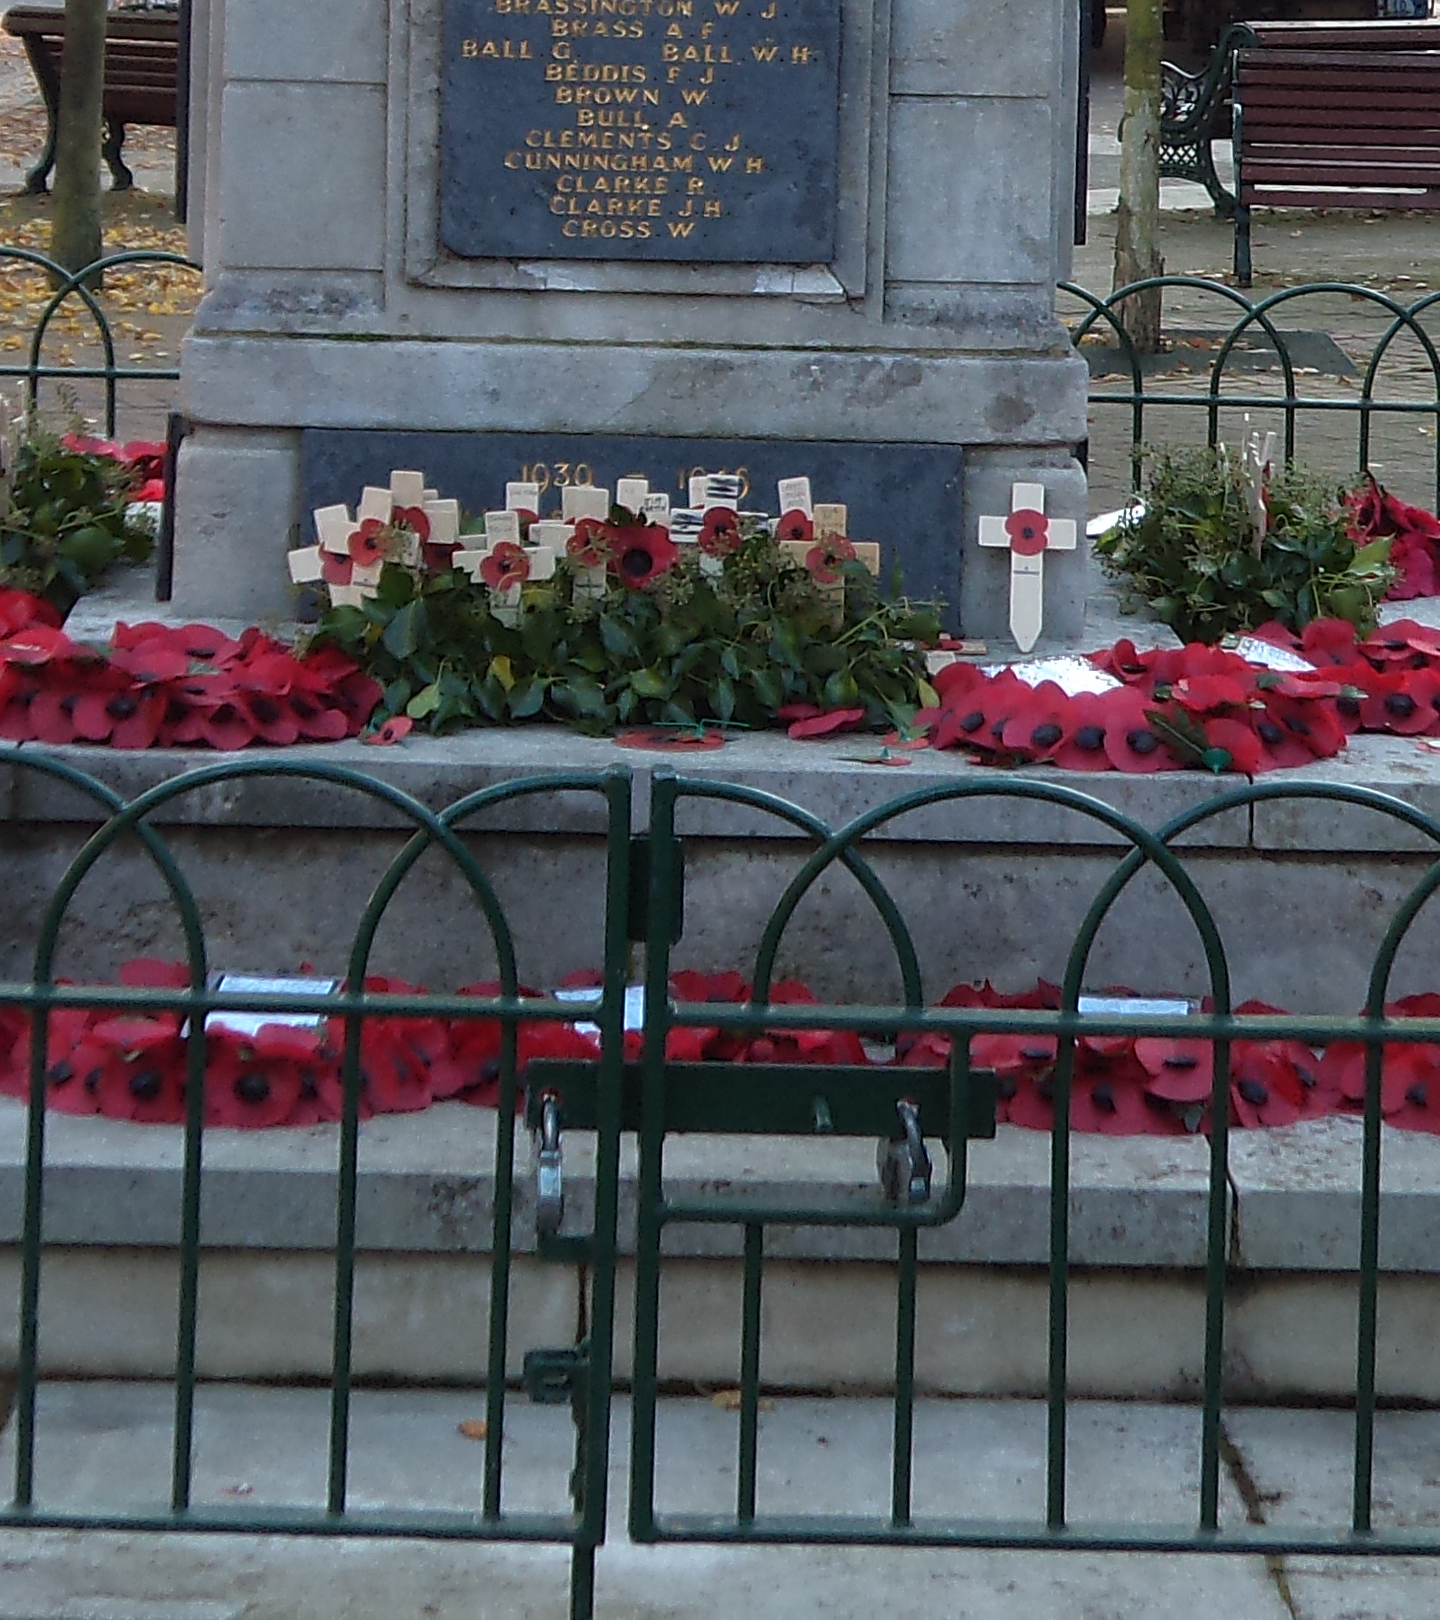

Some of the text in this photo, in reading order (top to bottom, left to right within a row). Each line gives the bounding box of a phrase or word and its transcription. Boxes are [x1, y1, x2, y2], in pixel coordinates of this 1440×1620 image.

[551, 18, 645, 39] BRASS
[462, 39, 534, 59] BALL
[662, 43, 733, 63] BALL
[545, 63, 647, 83] BEDDIS
[555, 86, 659, 105] BROWN
[577, 108, 649, 128] BULL
[525, 130, 673, 150] CLEMENTS
[504, 152, 693, 173] CUNNINGHAM
[556, 175, 669, 194] CLARKE
[549, 196, 663, 217] CLARKE
[561, 219, 653, 239] CROSS
